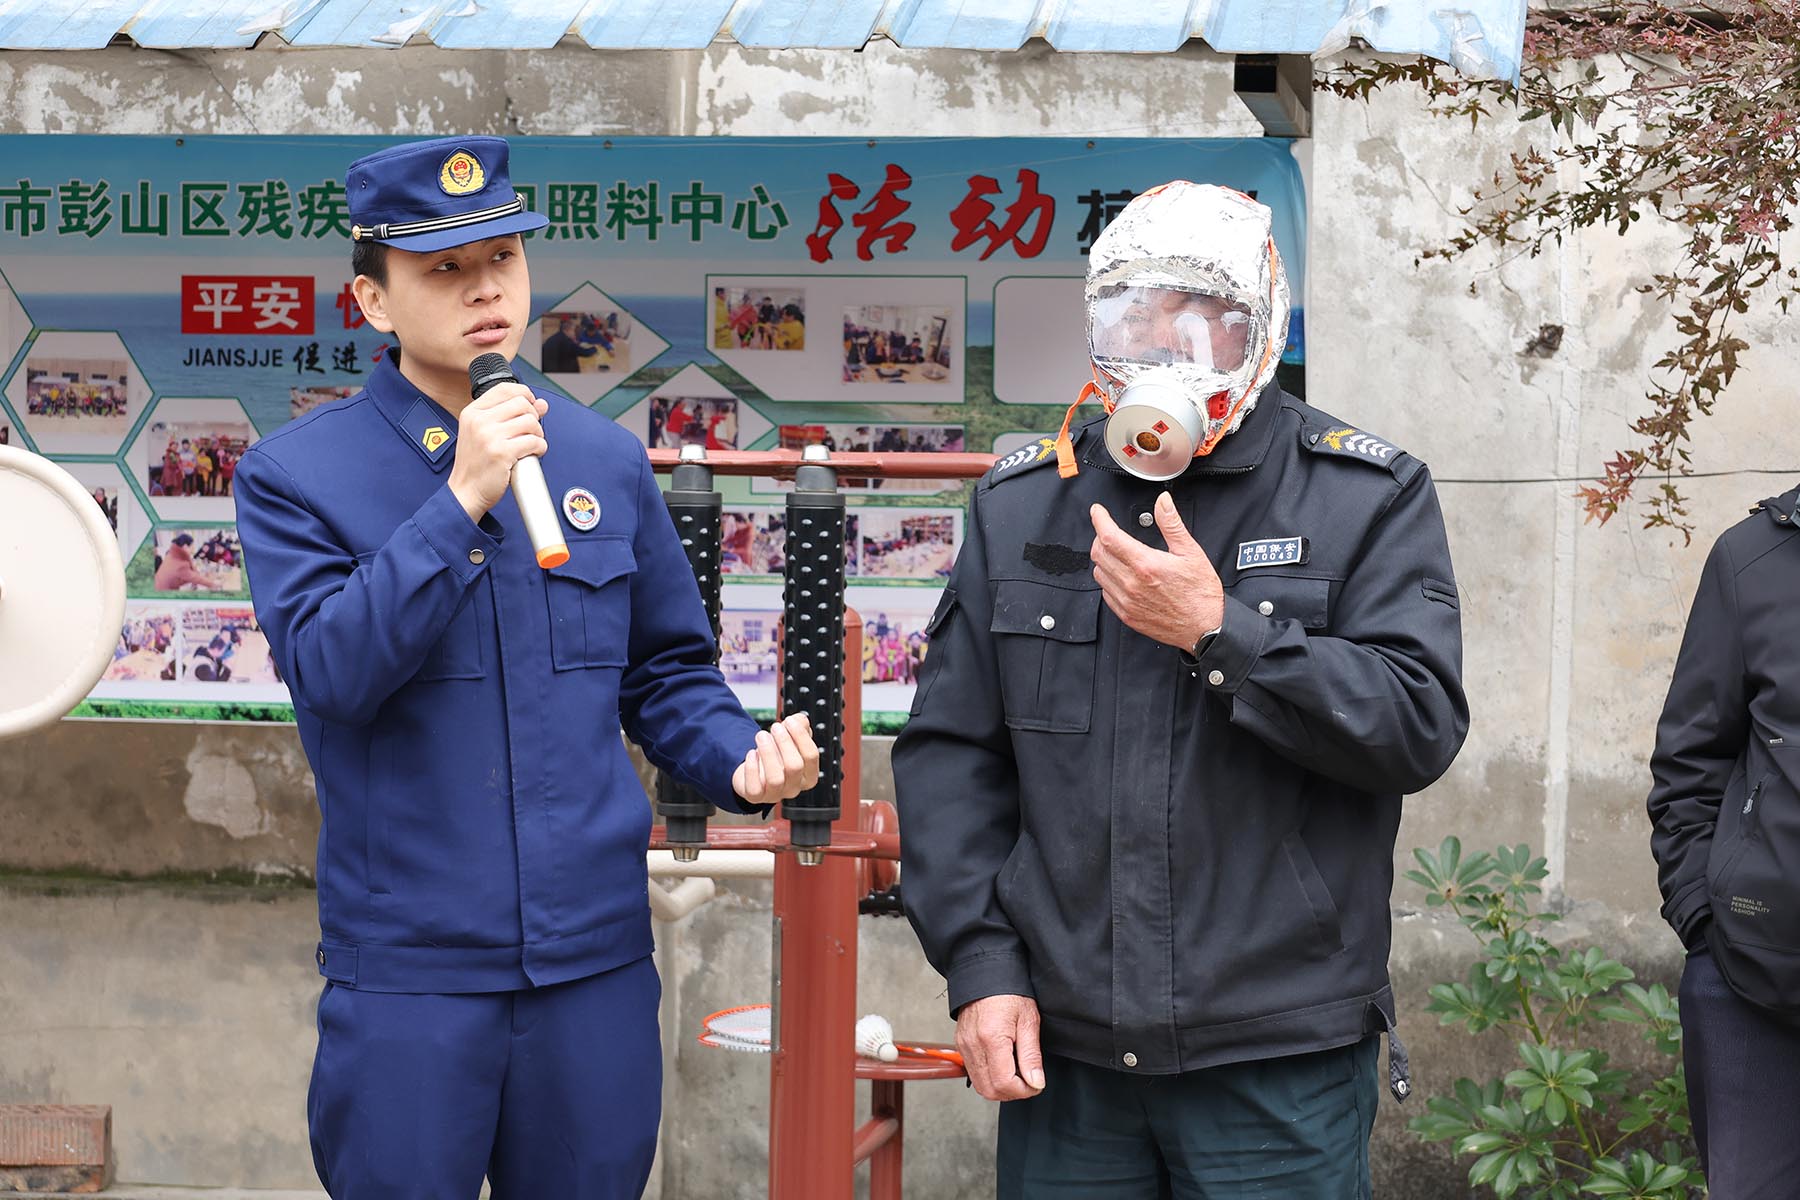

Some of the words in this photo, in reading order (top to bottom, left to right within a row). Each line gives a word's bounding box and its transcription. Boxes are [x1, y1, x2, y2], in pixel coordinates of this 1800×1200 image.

[805, 163, 1056, 263] 活动
[193, 281, 301, 330] 平安
[183, 348, 283, 367] JIANSJJE
[293, 341, 363, 375] 促进
[1243, 542, 1297, 556] 中国保安
[1246, 551, 1293, 563] 000043
[1731, 901, 1770, 913] PERSONALITY
